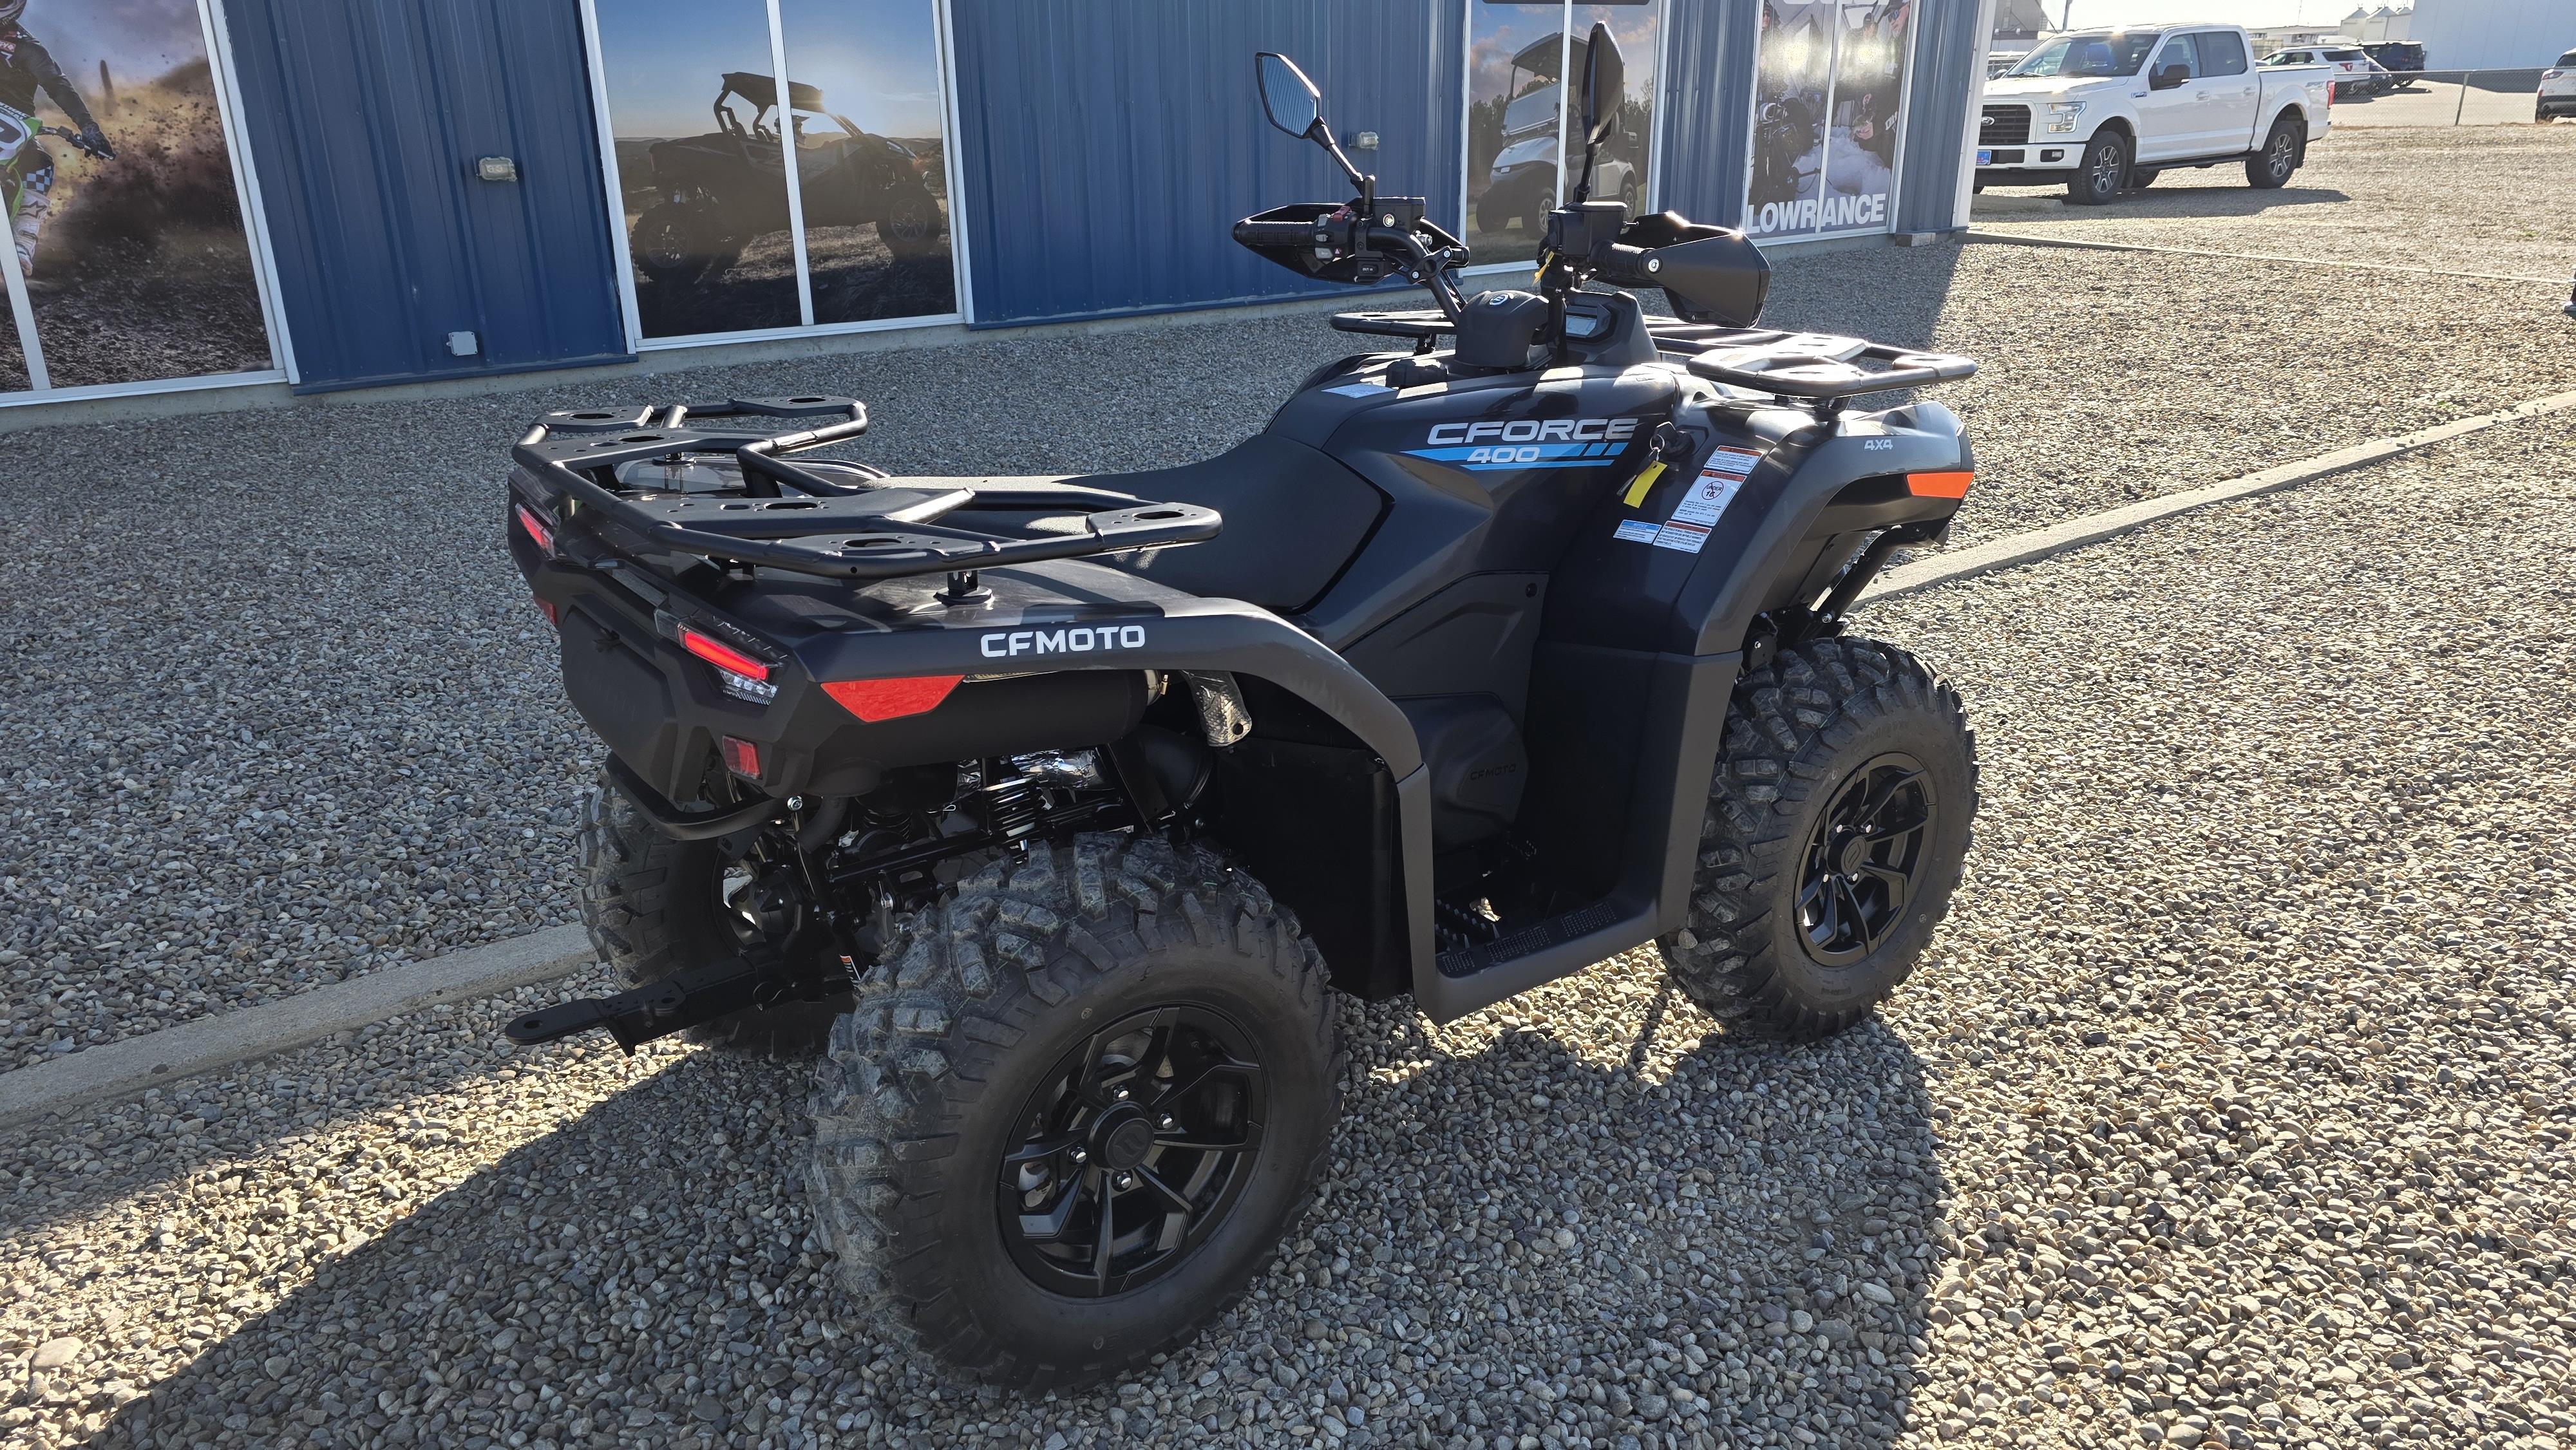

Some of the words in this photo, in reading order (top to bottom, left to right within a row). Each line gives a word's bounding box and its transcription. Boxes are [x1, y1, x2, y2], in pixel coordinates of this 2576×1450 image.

[1747, 193, 1886, 234] LOWRANCE
[1427, 418, 1638, 445] CFORCE
[1466, 446, 1540, 464] 400
[1864, 439, 1893, 451] 4X4
[980, 625, 1146, 658] CFMOTO
[1469, 763, 1517, 782] CFMOTO
